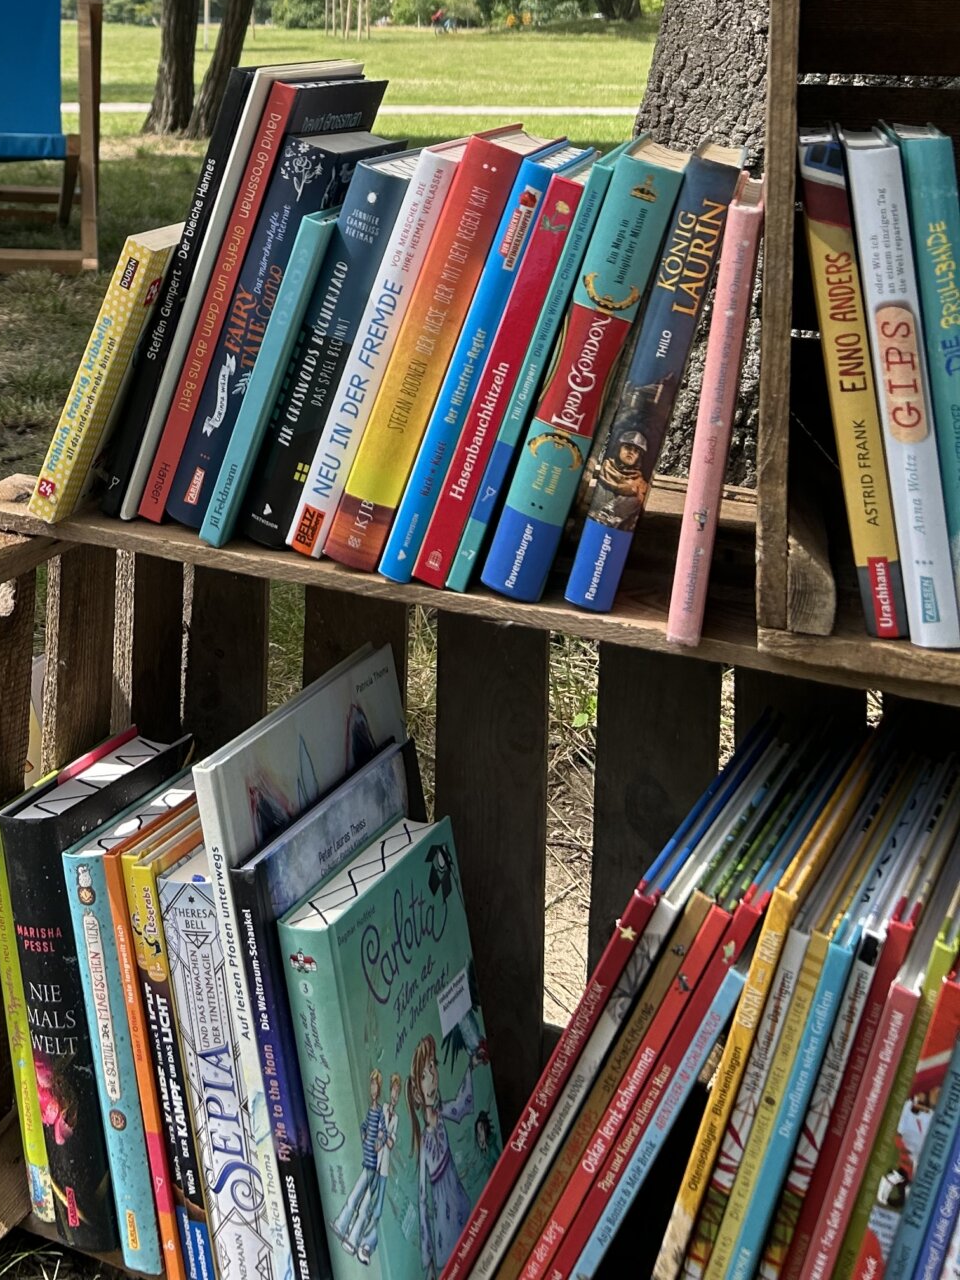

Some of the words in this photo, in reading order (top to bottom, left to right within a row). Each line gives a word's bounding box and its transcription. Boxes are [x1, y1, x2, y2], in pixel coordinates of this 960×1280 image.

[259, 112, 281, 150] David
[195, 157, 217, 197] Hannes
[238, 150, 269, 219] Grossman
[183, 199, 204, 237] bleiche
[275, 203, 291, 241] Internat
[400, 251, 414, 272] IHRE
[408, 217, 426, 249] HEIMAT
[421, 167, 444, 215] VERLASSEN
[177, 237, 192, 259] Der
[220, 224, 246, 272] Giraffe
[652, 208, 700, 292] KÖNIG
[669, 197, 729, 318] LAURIN
[120, 258, 137, 288] DUDEN
[159, 268, 183, 317] Gumpert
[211, 273, 230, 301] und
[253, 278, 263, 293] Das
[819, 250, 861, 325] ANDERS
[200, 302, 221, 338] dann
[220, 283, 260, 354] FAIRY
[326, 316, 350, 357] BEGINNT
[358, 278, 403, 369] FREMDE
[146, 319, 168, 360] Steffen
[194, 339, 209, 358] ab
[187, 358, 203, 379] ins
[317, 358, 336, 384] SPIEL
[449, 326, 489, 406] Hitzefrei-Regler
[832, 331, 869, 394] ENNO
[880, 319, 921, 429] GIPS
[176, 380, 196, 412] Bett!
[310, 386, 328, 407] DAS
[341, 373, 370, 418] DER
[443, 406, 460, 425] Der
[330, 422, 353, 449] IN
[447, 359, 512, 500] Hasenbauchkitzeln
[852, 419, 871, 468] FRANK
[149, 461, 171, 505] Hanser
[186, 467, 204, 503] CARLSEN
[313, 453, 343, 498] NEU
[904, 453, 920, 492] Woltz
[859, 473, 880, 527] ASTRID
[910, 498, 926, 535] Anna
[295, 506, 315, 544] BELTZ
[504, 522, 536, 589] Ravensburger
[584, 532, 614, 600] Ravensburger
[870, 562, 895, 628] Urachhaus
[210, 845, 231, 918] unterwegs
[16, 924, 62, 939] MARISHA
[185, 920, 206, 930] BELL
[222, 922, 238, 968] Pfoten
[360, 878, 448, 1005] Carlotta
[24, 940, 55, 952] PESSL
[242, 908, 267, 1011] Weltraum-Schaukel
[29, 982, 62, 1003] NIE
[189, 949, 203, 1002] ERWACHEN
[201, 952, 218, 1023] TINTENMAGIE
[231, 971, 246, 1012] leisen
[27, 1006, 76, 1029] MALS
[155, 992, 173, 1043] LICHT
[197, 1004, 206, 1023] DAS
[238, 1014, 250, 1040] Auf
[259, 1012, 270, 1030] Die
[30, 1029, 78, 1055] WELT
[166, 1044, 174, 1063] DAS
[200, 1026, 210, 1047] UND
[211, 1026, 221, 1044] DER
[169, 1063, 177, 1078] UM
[711, 1045, 745, 1117] Blankenhagen
[169, 1077, 188, 1138] KAMPF
[197, 1041, 264, 1212] SEPIA
[302, 1073, 347, 1154] Carlotta
[579, 1137, 608, 1173] Oskar
[597, 1107, 623, 1139] lernt
[611, 1044, 656, 1110] schwimmen
[180, 1139, 189, 1157] DER
[616, 1121, 641, 1155] Konrad
[262, 1153, 276, 1195] Thoma
[597, 1168, 618, 1193] Papa
[607, 1153, 624, 1172] und
[285, 1174, 299, 1213] THEISS
[269, 1201, 284, 1247] Patricia
[291, 1214, 306, 1258] LAURAS
